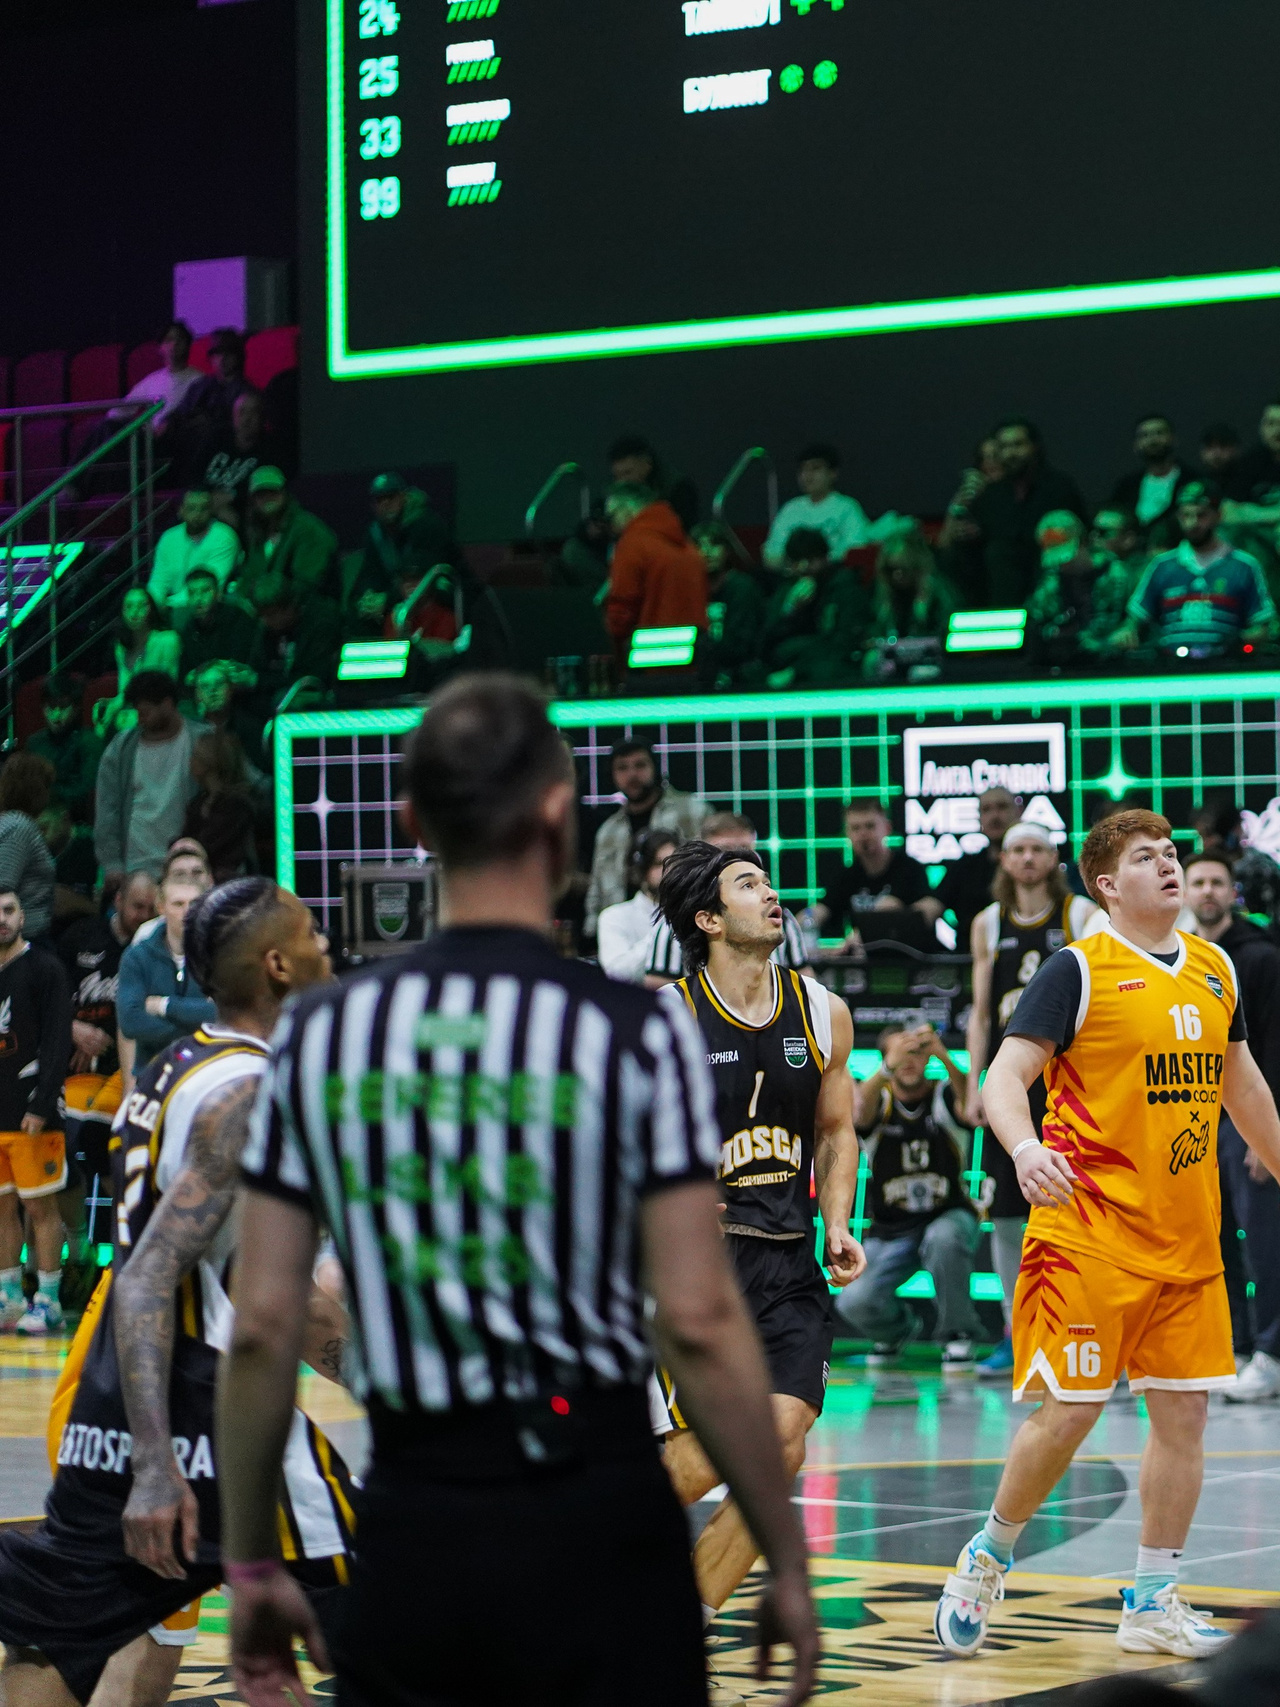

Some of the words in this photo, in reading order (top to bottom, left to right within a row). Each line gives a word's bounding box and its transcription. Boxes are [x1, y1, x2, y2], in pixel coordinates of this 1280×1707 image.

[359, 55, 399, 100] 25
[359, 115, 401, 160] 33
[359, 176, 401, 221] 99
[905, 795, 1067, 835] MEA
[1118, 981, 1146, 993] RED
[1168, 1003, 1203, 1042] 16
[1145, 1052, 1224, 1087] MASTER
[738, 1170, 789, 1188] COMMUNITY
[1062, 1340, 1102, 1378] 16
